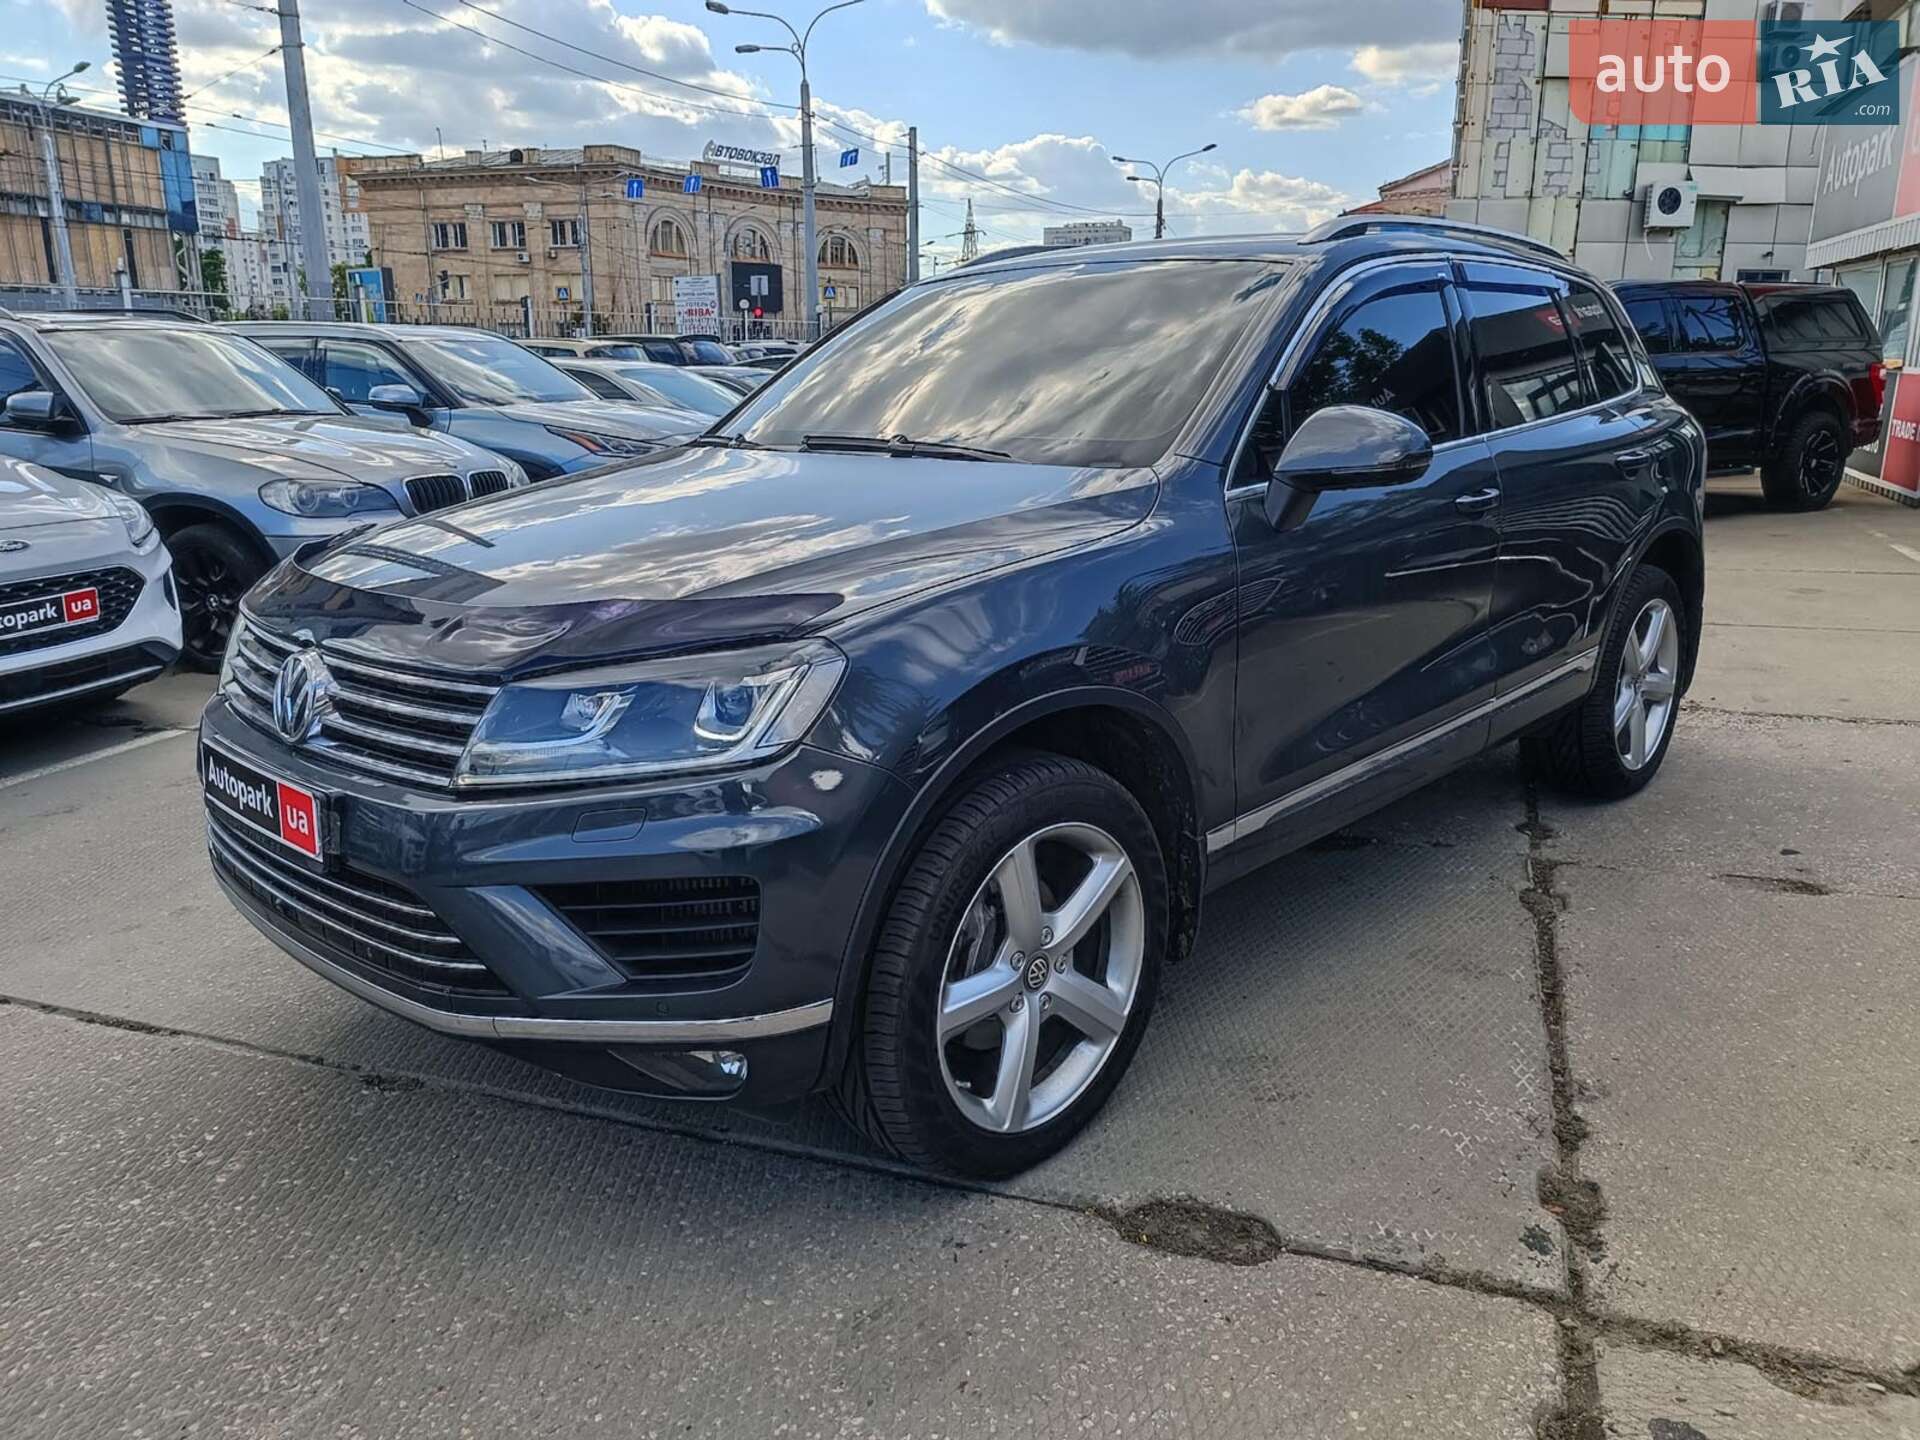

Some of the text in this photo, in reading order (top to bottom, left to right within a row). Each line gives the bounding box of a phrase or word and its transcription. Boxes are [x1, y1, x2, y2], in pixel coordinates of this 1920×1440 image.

[1823, 122, 1897, 198] Autopark
[1891, 419, 1915, 440] TRADE
[0, 599, 92, 630] opark ua
[208, 755, 274, 818] Autopark
[286, 804, 310, 835] ua
